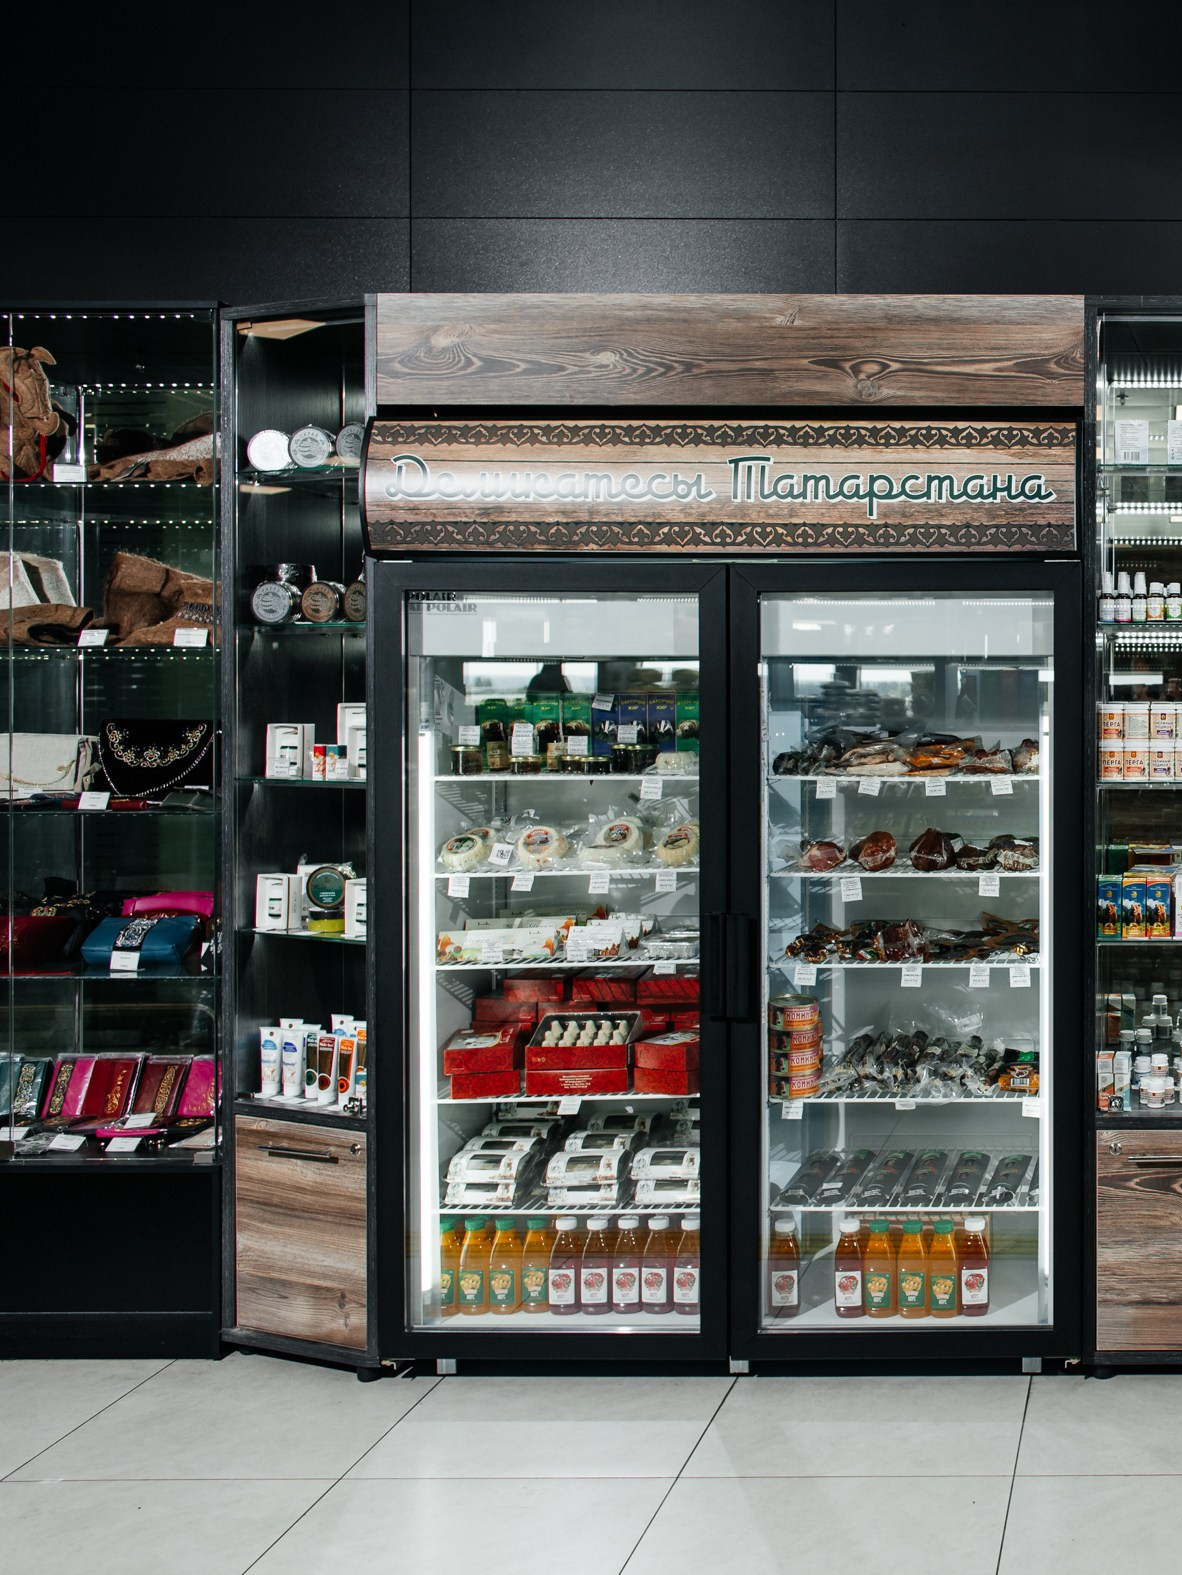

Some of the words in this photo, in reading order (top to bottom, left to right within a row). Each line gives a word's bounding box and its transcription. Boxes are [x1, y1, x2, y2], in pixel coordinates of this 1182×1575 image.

[384, 454, 716, 502] Деликатесы
[727, 455, 1057, 520] Татарстана
[407, 591, 456, 601] POLAIR
